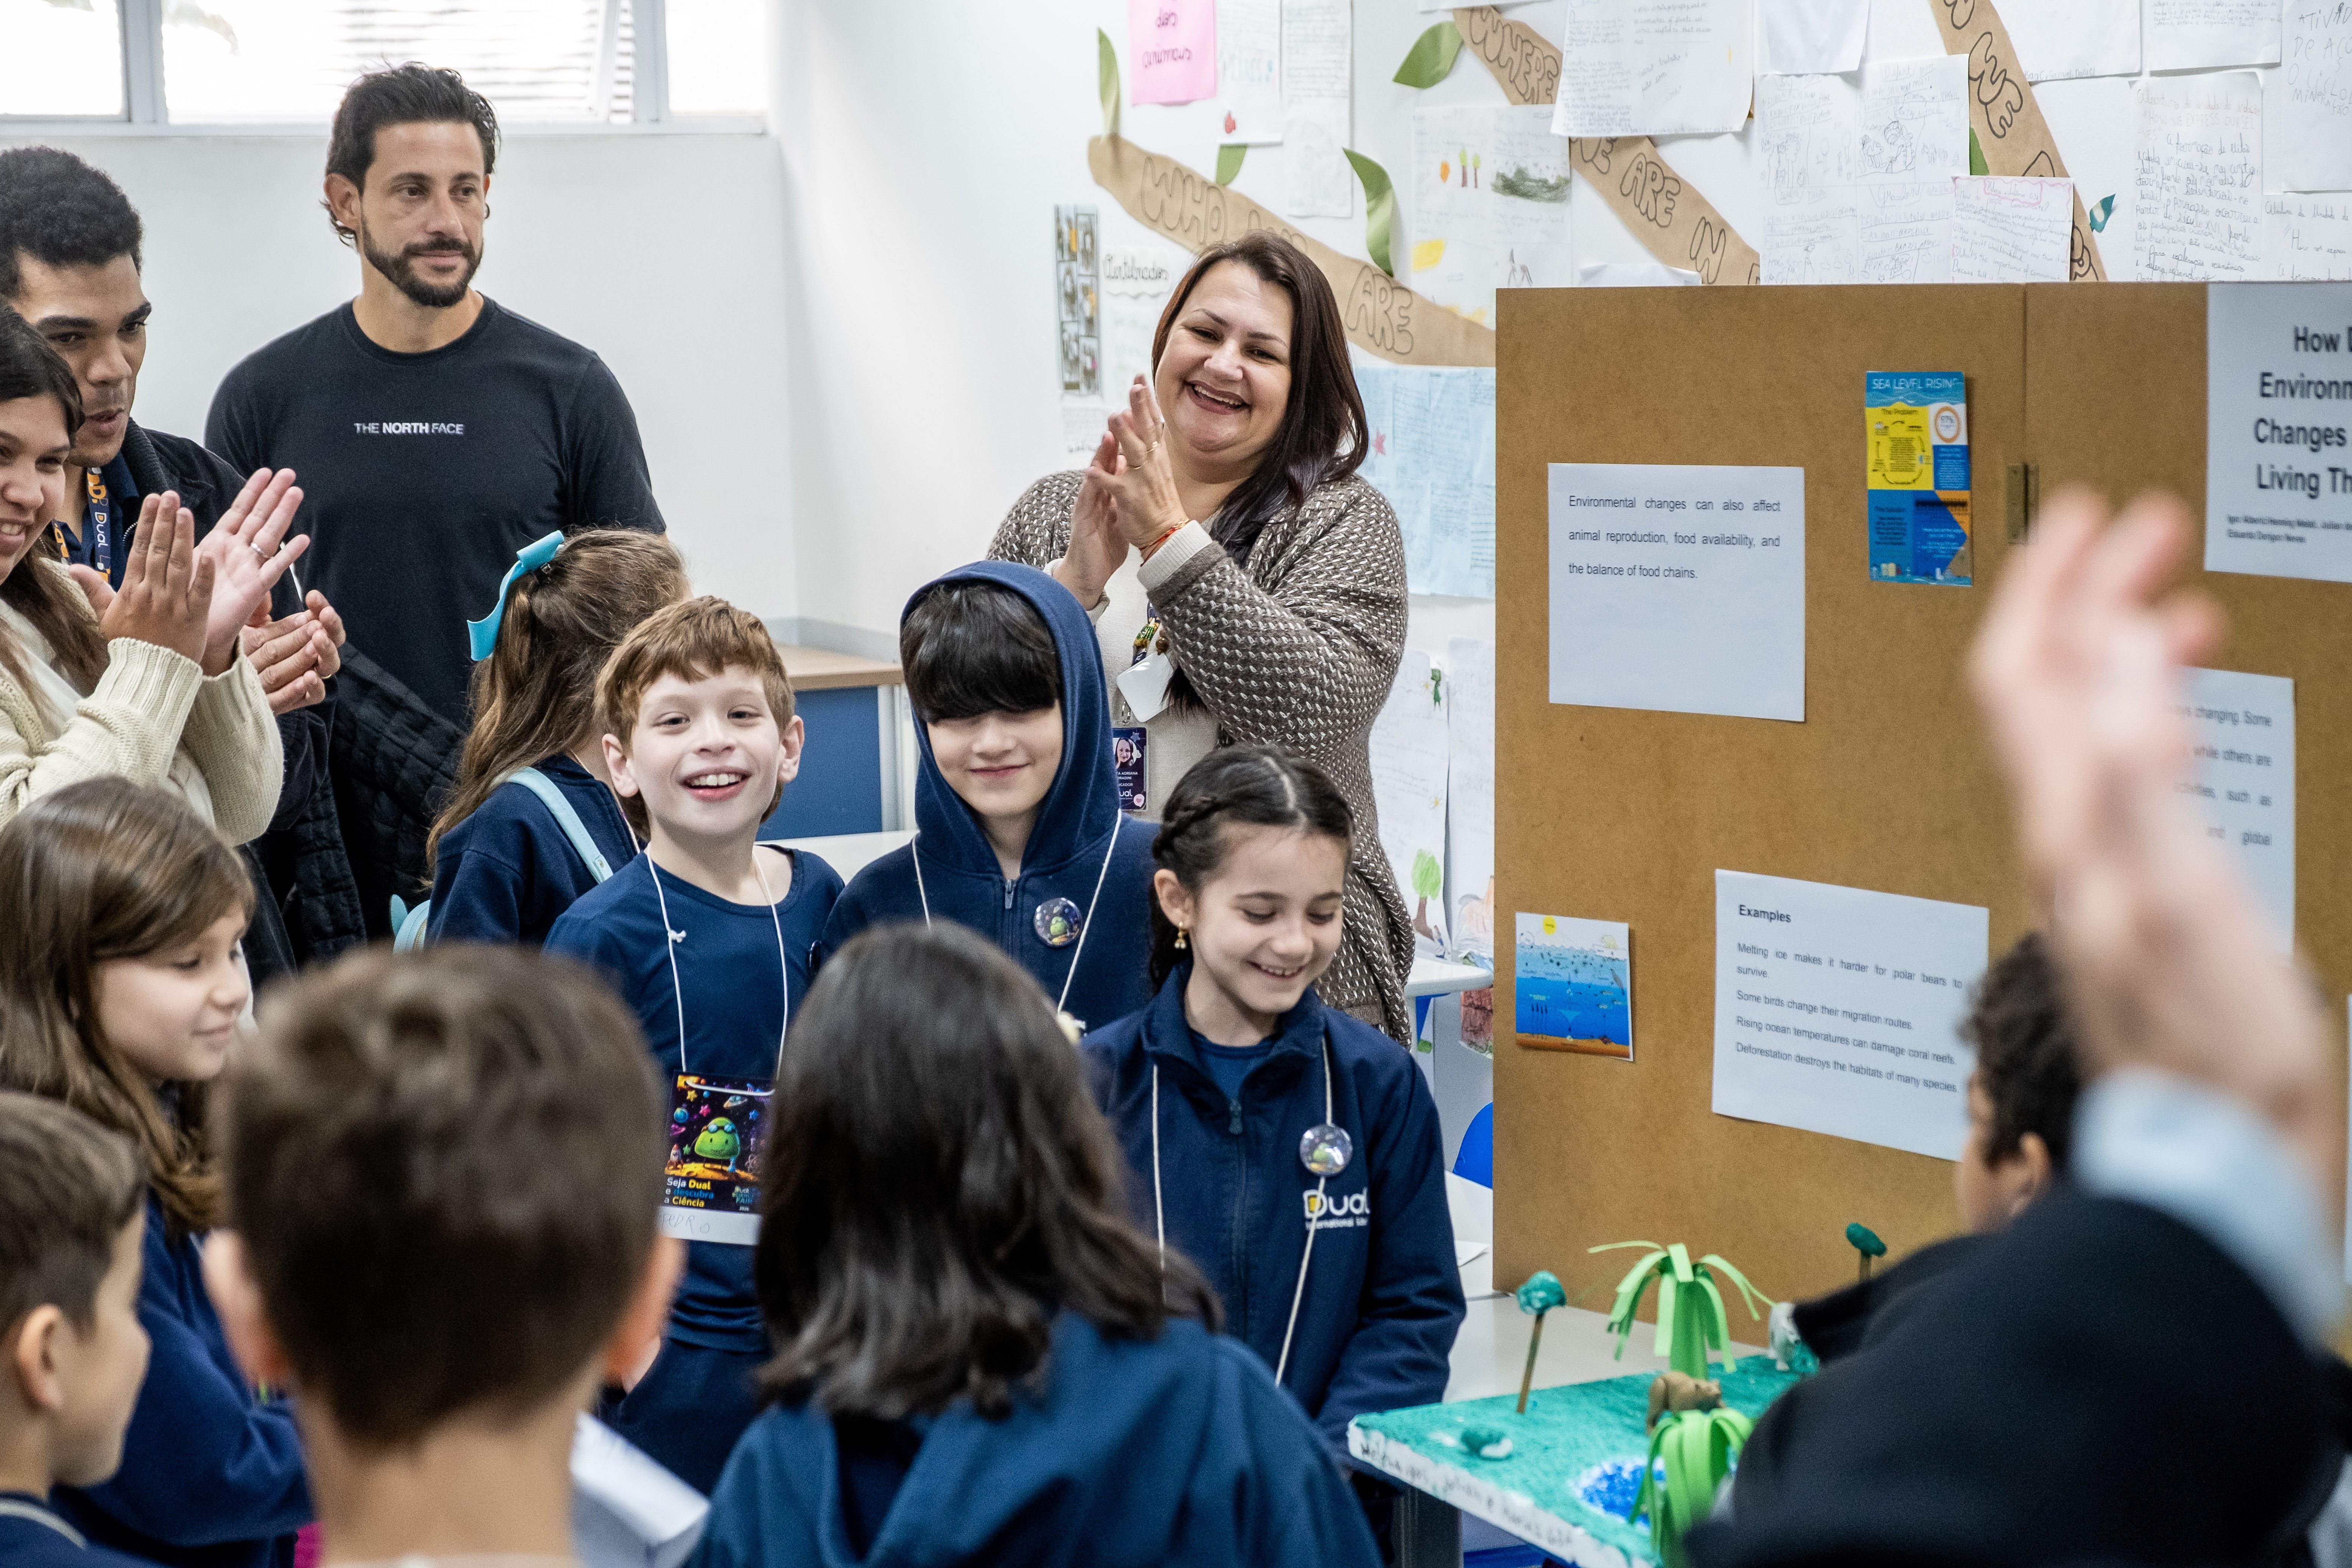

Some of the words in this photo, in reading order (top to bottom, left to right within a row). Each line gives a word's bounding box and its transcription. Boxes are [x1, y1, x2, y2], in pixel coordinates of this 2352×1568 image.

[1620, 152, 1681, 228] ARE
[1344, 264, 1415, 356] ARE
[2294, 326, 2341, 352] How
[1872, 378, 1891, 389] SEA
[1893, 378, 1924, 389] LEVEL
[354, 422, 380, 434] THE
[382, 422, 430, 435] NORTH
[431, 423, 465, 435] FACE
[2254, 418, 2347, 453] Changes
[2256, 463, 2320, 499] Living
[1569, 495, 1636, 508] Environmental
[1645, 497, 1686, 512] changes
[1696, 501, 1713, 510] can
[1723, 499, 1744, 510] also
[1753, 499, 1781, 511] affect
[95, 511, 109, 548] Dual
[1569, 529, 1600, 541] animal
[1606, 531, 1668, 544] reproduction,
[1674, 532, 1696, 544] food
[1702, 534, 1755, 549] availability,
[1761, 535, 1780, 546] and
[1569, 563, 1584, 574] the
[1586, 563, 1624, 575] balance
[1627, 565, 1637, 575] of
[1639, 565, 1660, 577] food
[1663, 566, 1698, 578] chains.
[1739, 904, 1791, 923] Examples
[1737, 943, 1769, 958] Melting
[1775, 948, 1788, 960] ice
[1794, 952, 1823, 966] makes
[1829, 956, 1834, 967] it
[1840, 959, 1869, 973] harder
[1874, 965, 1888, 976] for
[1892, 969, 1916, 981] polar
[1921, 972, 1948, 986] bears
[1953, 978, 1963, 988] to
[1737, 965, 1770, 979] survive.
[1737, 990, 1762, 1003] Some
[1763, 995, 1785, 1007] birds
[1786, 999, 1819, 1014] change
[1821, 1005, 1839, 1016] their
[1843, 1010, 1882, 1025] migration
[1885, 1016, 1914, 1031] routes.
[1736, 1015, 1763, 1031] Rising
[1765, 1022, 1792, 1034] ocean
[1794, 1027, 1850, 1045] temperatures
[1852, 1038, 1868, 1049] can
[1871, 1040, 1906, 1057] damage
[1908, 1048, 1930, 1060] coral
[1932, 1052, 1957, 1065] reefs.
[1736, 1042, 1793, 1062] Deforestation
[1795, 1054, 1831, 1070] destroys
[1834, 1060, 1847, 1072] the
[1849, 1062, 1884, 1079] habitats
[1885, 1070, 1894, 1080] of
[1896, 1073, 1921, 1089] many
[1923, 1078, 1959, 1093] species.
[667, 1177, 686, 1188] Seja
[688, 1179, 711, 1190] Dual
[673, 1188, 715, 1199] descubra
[672, 1196, 705, 1208] Ciência
[1303, 1186, 1371, 1219] Dual
